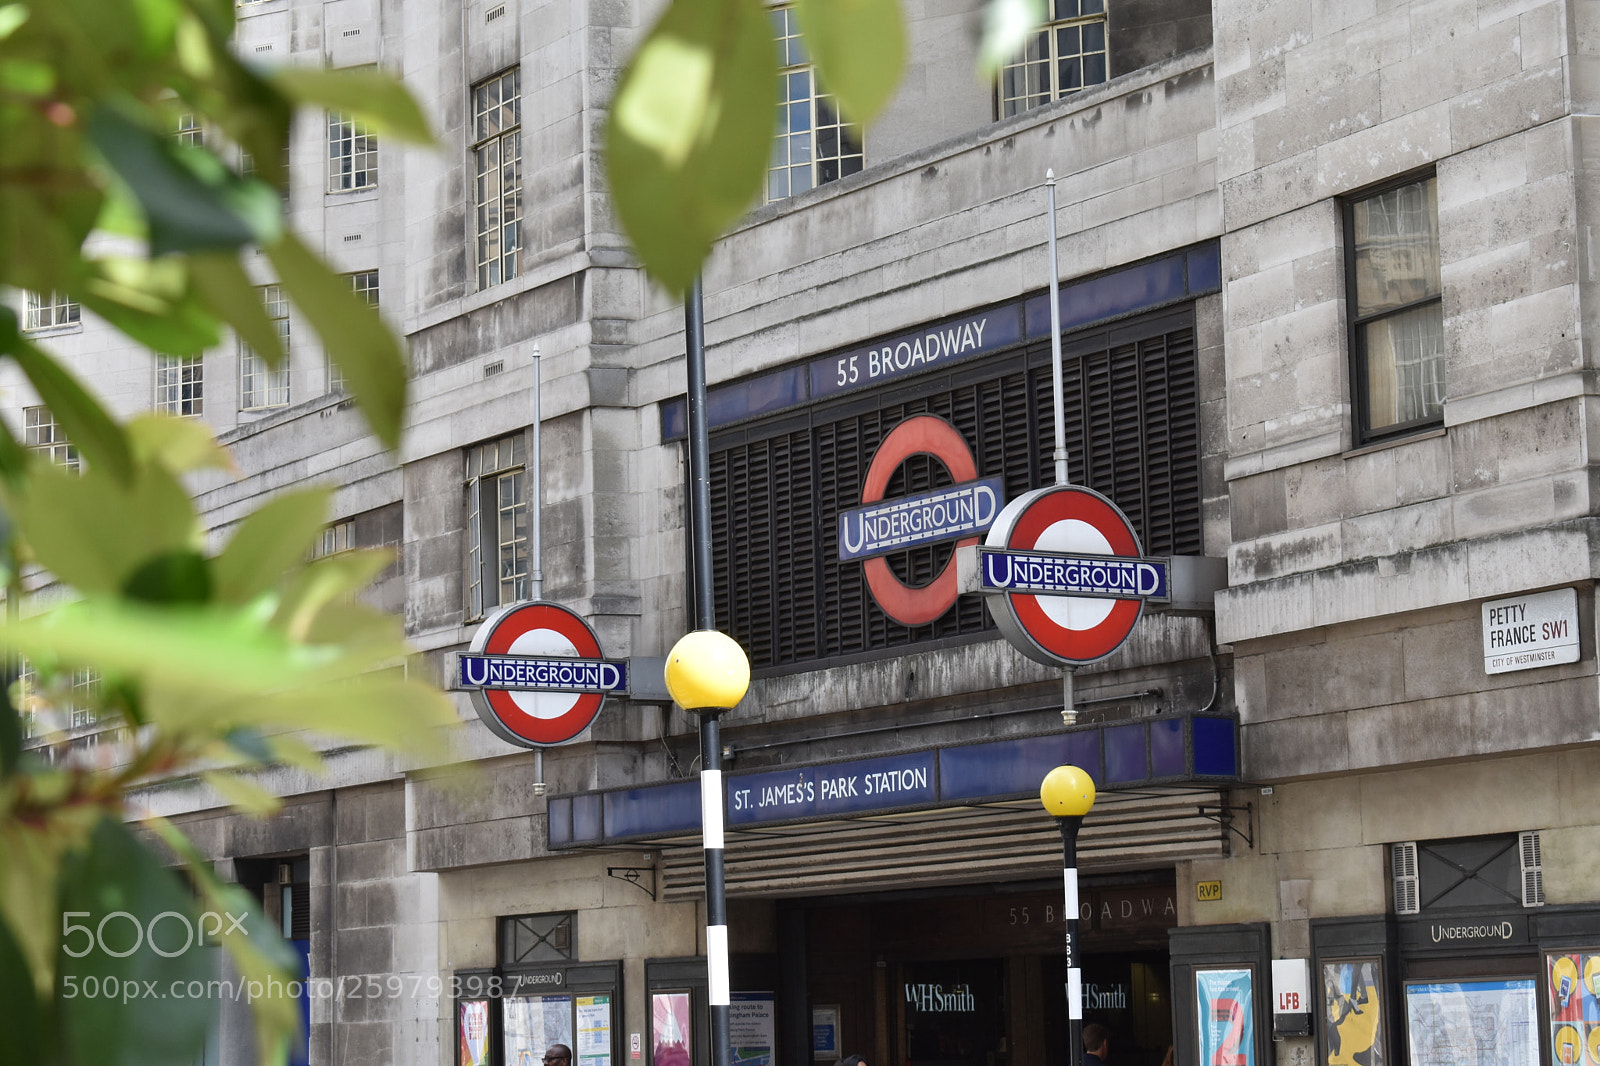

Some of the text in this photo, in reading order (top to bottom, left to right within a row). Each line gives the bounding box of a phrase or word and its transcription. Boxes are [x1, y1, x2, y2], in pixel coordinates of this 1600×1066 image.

[836, 317, 987, 387] 55 BROADWAY
[843, 485, 997, 554] UNDERGROUND
[988, 553, 1160, 596] UNDERGROUND
[1489, 602, 1526, 626] PETTY
[1491, 619, 1569, 648] FRANCE SW1
[466, 657, 621, 690] UNDERGROUND
[1492, 650, 1556, 668] CITY OF WESTMINSTER
[734, 767, 927, 810] ST. JAMES'S PARK STATION
[1199, 884, 1220, 899] RVP
[1010, 897, 1176, 926] 55 BOADWA
[1431, 921, 1513, 943] UNDERGROUND
[905, 983, 975, 1012] WHSmith
[1279, 991, 1300, 1010] LFB
